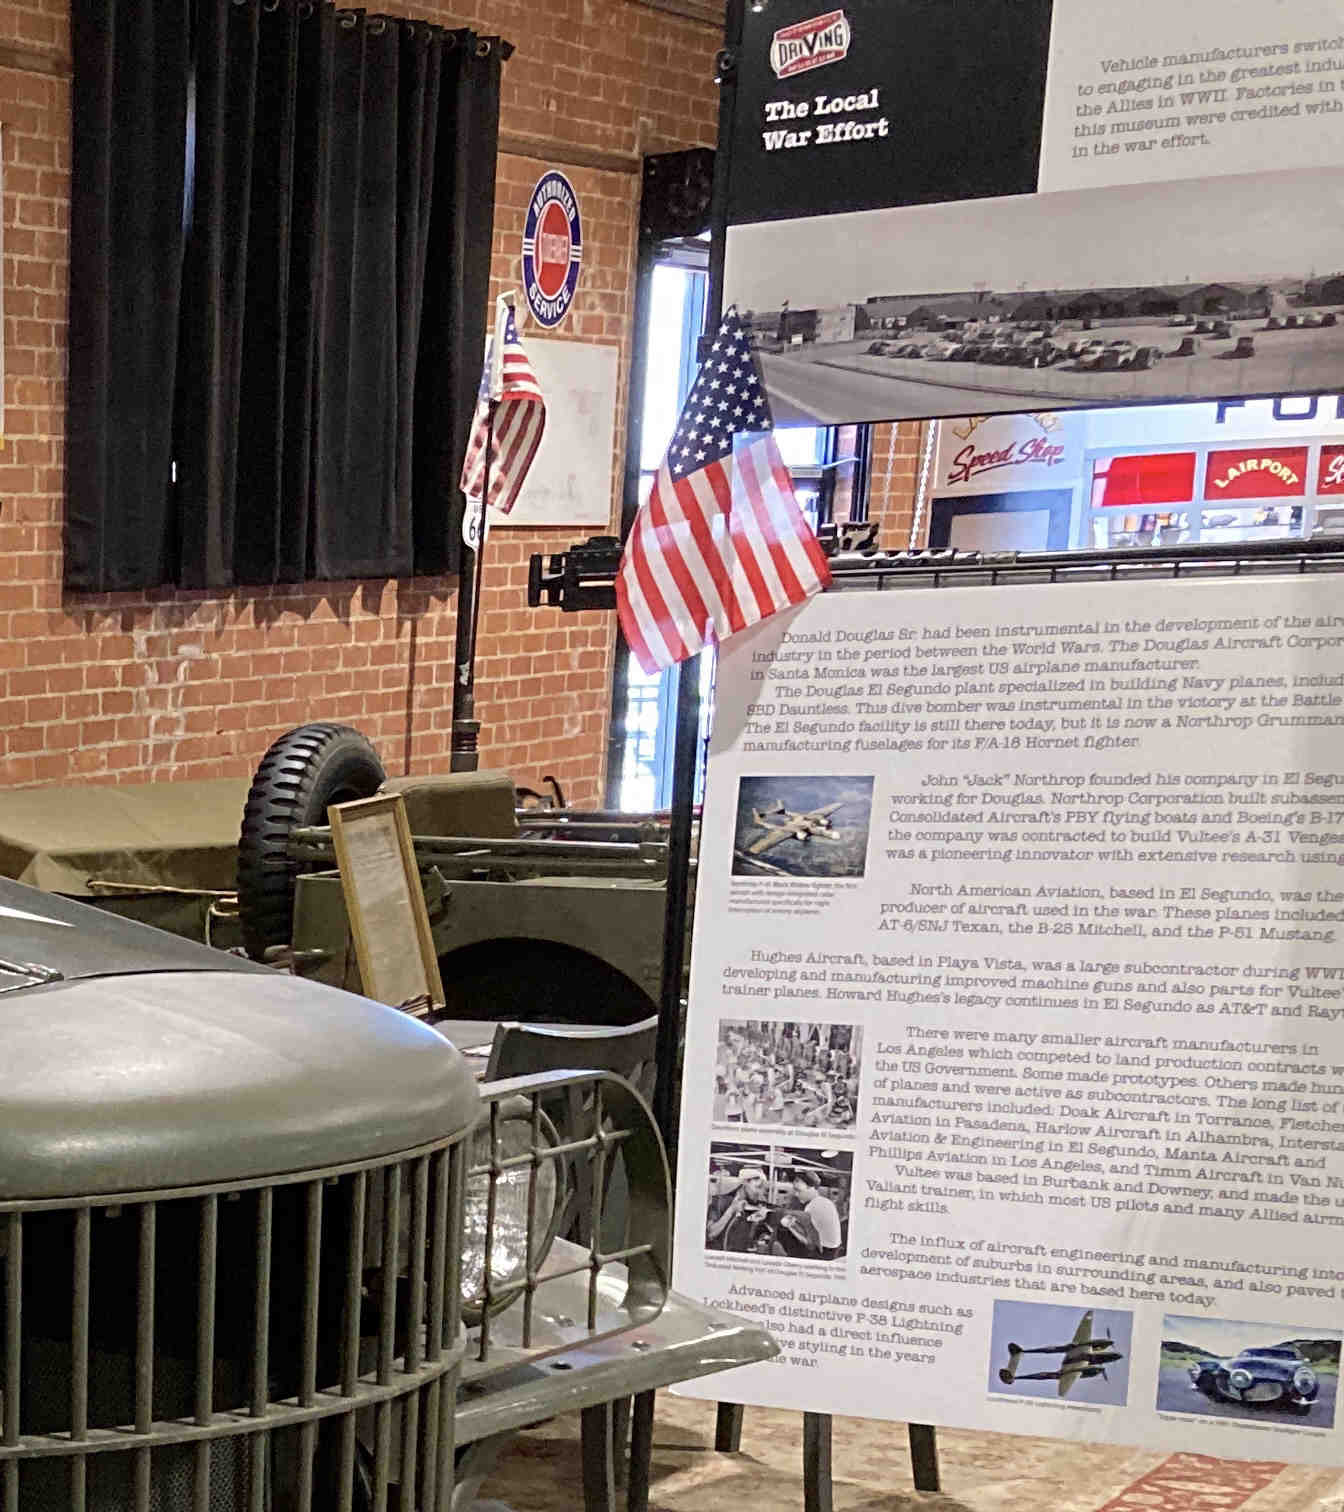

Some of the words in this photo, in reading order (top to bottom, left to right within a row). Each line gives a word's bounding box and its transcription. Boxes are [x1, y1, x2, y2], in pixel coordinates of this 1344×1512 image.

[778, 23, 844, 66] DRIVING
[1101, 56, 1159, 74] Vehicle
[1163, 43, 1288, 68] manufacturers
[1078, 83, 1094, 97] to
[1098, 74, 1173, 95] engaging
[1178, 71, 1195, 85] in
[1200, 69, 1226, 84] the
[1230, 62, 1300, 83] greatest
[765, 101, 809, 122] The
[814, 88, 880, 116] Local
[1076, 103, 1102, 118] the
[1107, 98, 1153, 116] Allies
[1158, 95, 1174, 109] in
[1235, 80, 1313, 101] Factories
[1319, 79, 1335, 92] in
[762, 130, 812, 151] War
[815, 116, 889, 145] Effort
[1074, 121, 1105, 138] this
[1111, 116, 1180, 135] museum
[1185, 112, 1226, 126] were
[1230, 102, 1300, 123] credited
[1305, 100, 1343, 116] with
[1071, 144, 1088, 159] in
[1094, 139, 1120, 156] the
[1124, 138, 1157, 153] war
[1161, 132, 1210, 150] effort.
[533, 180, 576, 222] AUTHORIZED
[529, 283, 571, 319] SERVICE
[949, 443, 1013, 484] Speed
[1014, 438, 1063, 466] Shop
[1214, 459, 1299, 488] LAIRPORT
[782, 631, 831, 644] Donald
[836, 629, 894, 643] Douglas
[922, 628, 950, 640] had
[955, 626, 990, 639] been
[996, 621, 1098, 638] instrumental
[1104, 622, 1119, 633] in
[1125, 620, 1150, 632] the
[1155, 617, 1259, 634] development
[1263, 616, 1282, 628] of
[1283, 616, 1311, 627] the
[752, 648, 813, 665] industry
[818, 649, 832, 662] in
[837, 648, 861, 661] the
[864, 646, 911, 664] period
[915, 646, 977, 659] between
[983, 644, 1008, 657] the
[1013, 641, 1055, 656] World
[1109, 640, 1139, 652] The
[1144, 638, 1208, 654] Douglas
[1214, 635, 1282, 650] Aircraft
[750, 669, 764, 681] in
[768, 667, 810, 680] Santa
[814, 666, 866, 679] Monica
[870, 666, 899, 677] was
[903, 664, 928, 677] the
[931, 662, 984, 679] largest
[988, 662, 1009, 674] US
[1012, 659, 1079, 676] airplane
[909, 883, 953, 896] North
[957, 884, 1032, 897] American
[1036, 885, 1105, 899] Aviation,
[1110, 887, 1154, 900] based
[1159, 888, 1175, 900] in
[1180, 888, 1196, 900] El
[1201, 887, 1274, 903] Segundo,
[1280, 890, 1312, 902] was
[1316, 890, 1344, 902] the
[880, 902, 948, 916] producer
[951, 902, 965, 914] of
[968, 903, 1028, 917] aircraft
[1033, 904, 1069, 916] used
[1072, 905, 1089, 917] in
[1094, 905, 1119, 917] the
[1163, 906, 1211, 919] These
[1216, 907, 1269, 922] planes
[1274, 908, 1344, 921] included
[877, 1042, 902, 1054] Los
[905, 1043, 964, 1058] Angeles
[968, 1047, 1013, 1060] which
[1017, 1050, 1090, 1065] competed
[1096, 1053, 1111, 1066] to
[1115, 1053, 1150, 1067] land
[1155, 1055, 1243, 1071] production
[1247, 1061, 1326, 1075] contracts
[703, 1296, 775, 1316] Lockheed's
[779, 1305, 853, 1323] distinctive
[856, 1312, 888, 1325] P-38
[891, 1315, 964, 1335] Lightning
[728, 1283, 795, 1300] Advanced
[799, 1291, 858, 1306] airplane
[862, 1296, 915, 1313] designs
[919, 1302, 953, 1316] such
[957, 1308, 973, 1318] as
[764, 1320, 786, 1332] lso
[788, 1321, 813, 1335] had
[830, 1327, 873, 1342] direct
[876, 1330, 943, 1348] influence
[798, 1340, 847, 1357] styling
[850, 1345, 865, 1357] in
[868, 1345, 892, 1359] the
[894, 1350, 936, 1365] years
